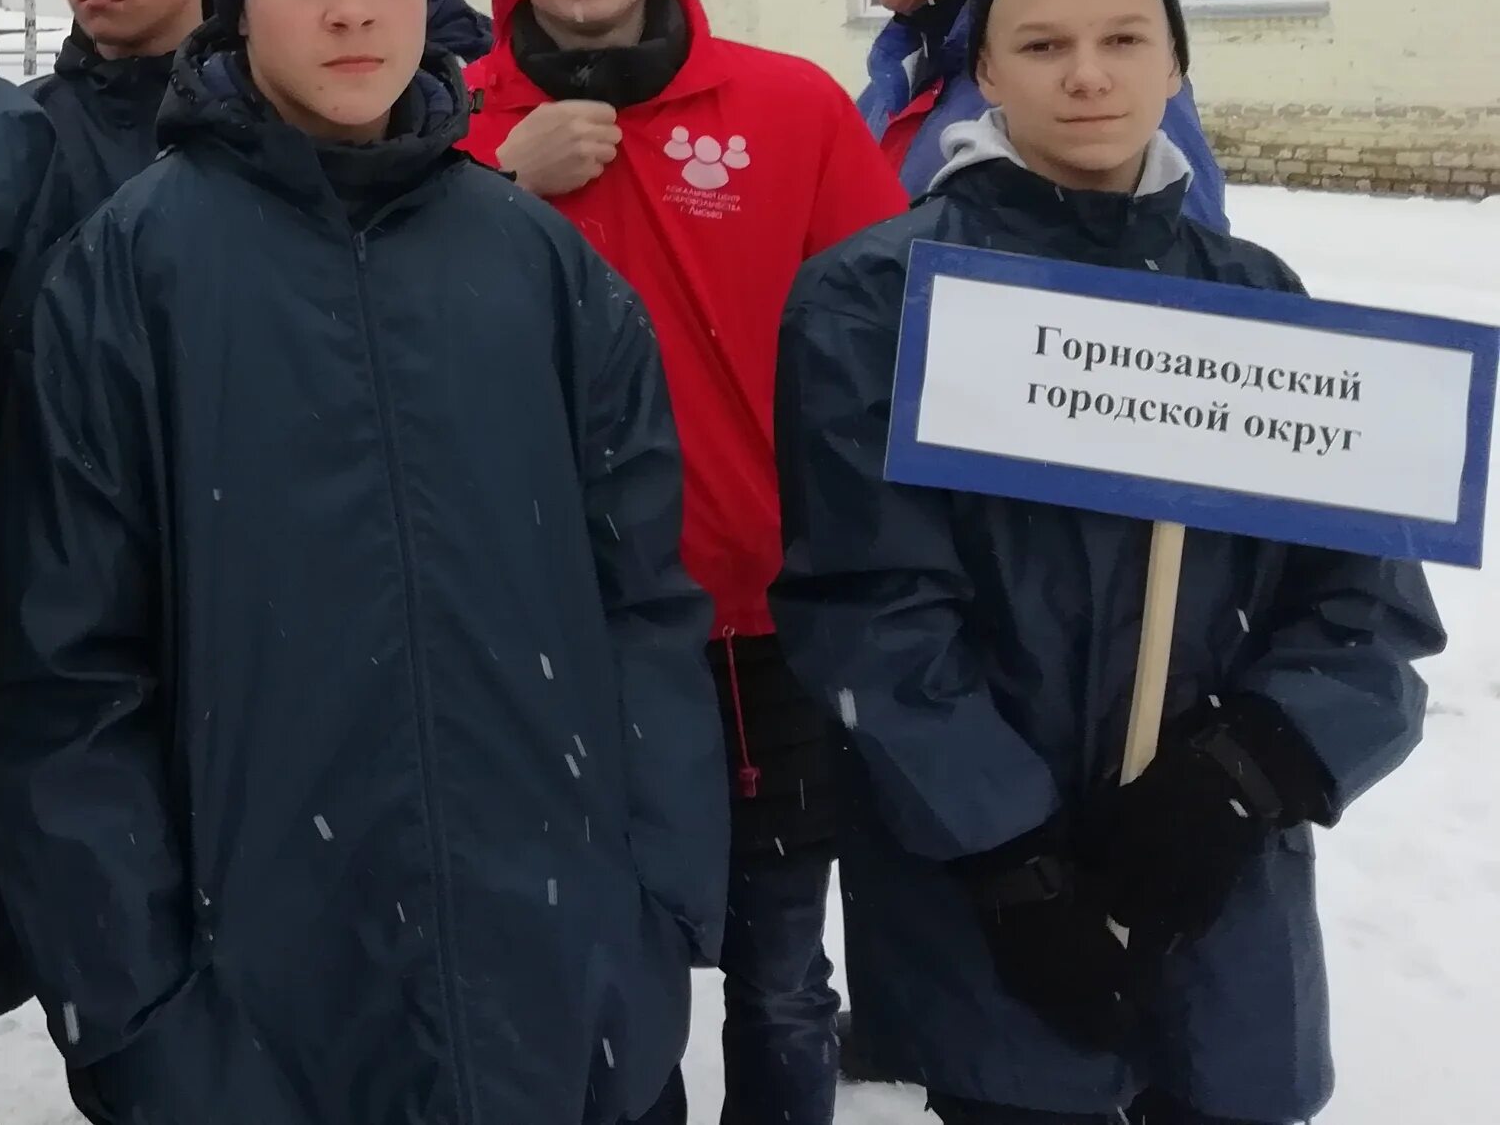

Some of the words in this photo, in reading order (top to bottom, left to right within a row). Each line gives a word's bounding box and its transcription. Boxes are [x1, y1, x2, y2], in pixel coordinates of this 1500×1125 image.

[1031, 324, 1362, 402] Горнозаводский
[1027, 381, 1232, 434] городской
[1243, 413, 1363, 456] округ
